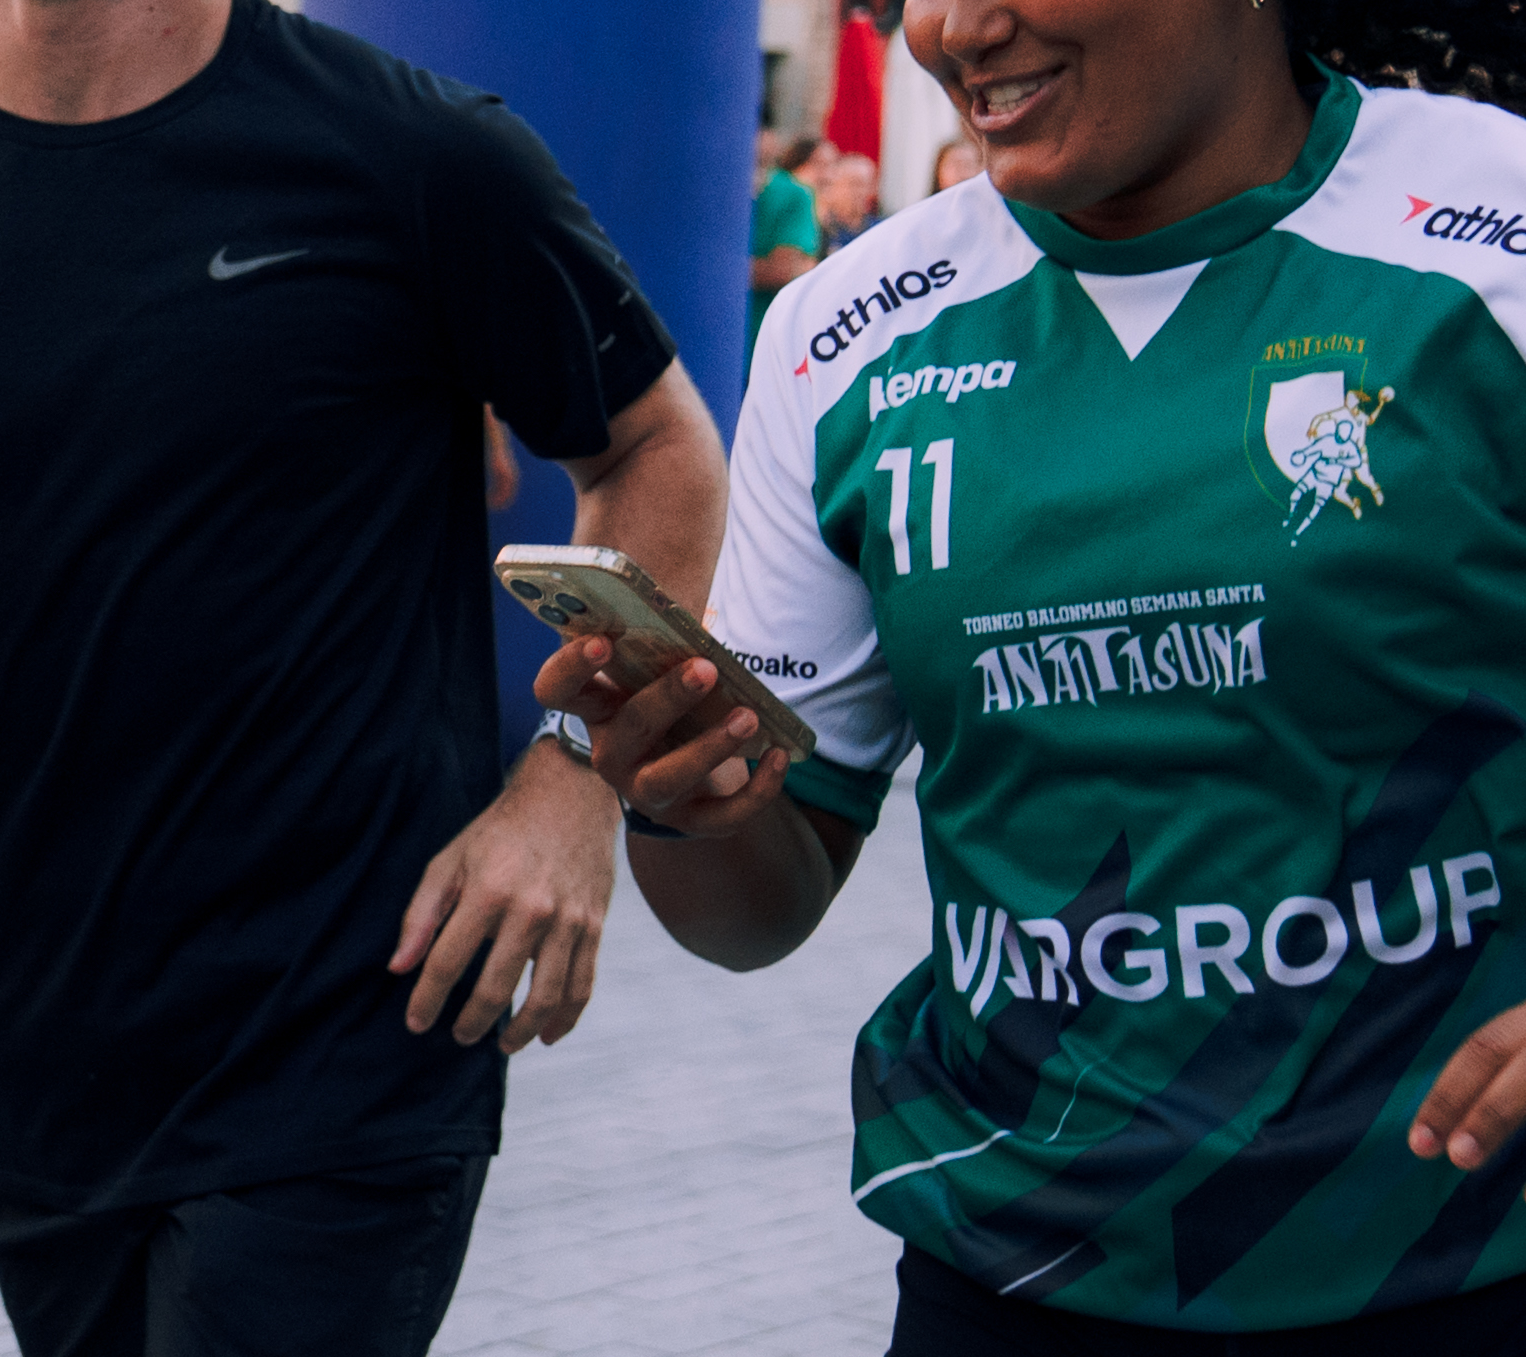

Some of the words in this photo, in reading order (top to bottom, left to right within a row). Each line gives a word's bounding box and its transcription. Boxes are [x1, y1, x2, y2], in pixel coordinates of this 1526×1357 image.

[810, 259, 958, 363] athlos
[874, 437, 955, 576] 11
[963, 610, 1025, 636] TORNEO
[1026, 597, 1129, 628] BALONMANO
[1131, 589, 1203, 616] SEMANA
[1204, 582, 1266, 607] SANTA
